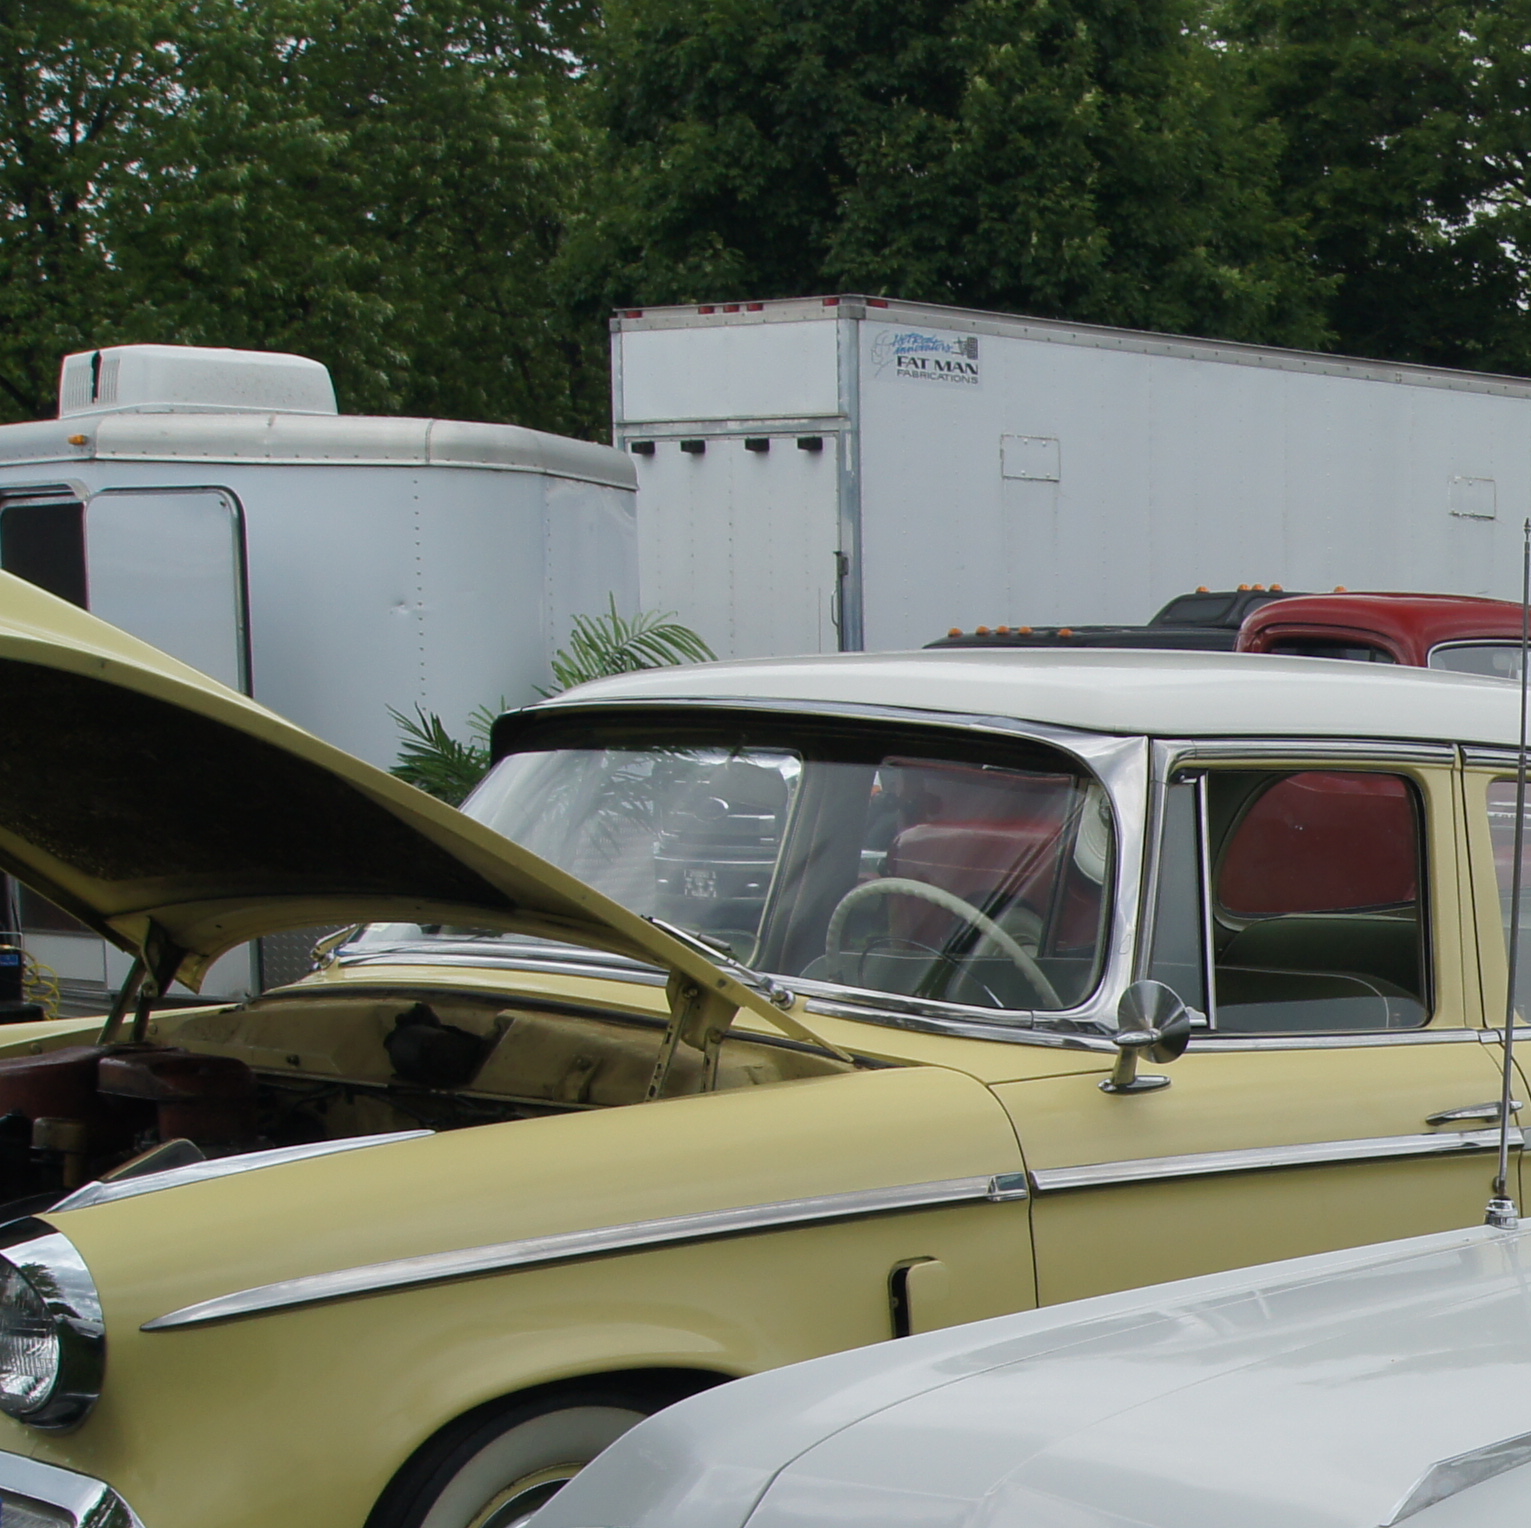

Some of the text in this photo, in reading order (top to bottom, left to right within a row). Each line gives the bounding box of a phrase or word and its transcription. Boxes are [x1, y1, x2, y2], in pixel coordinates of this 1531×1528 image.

[896, 355, 979, 375] FAT MAN
[896, 368, 979, 385] FABRICATIONS
